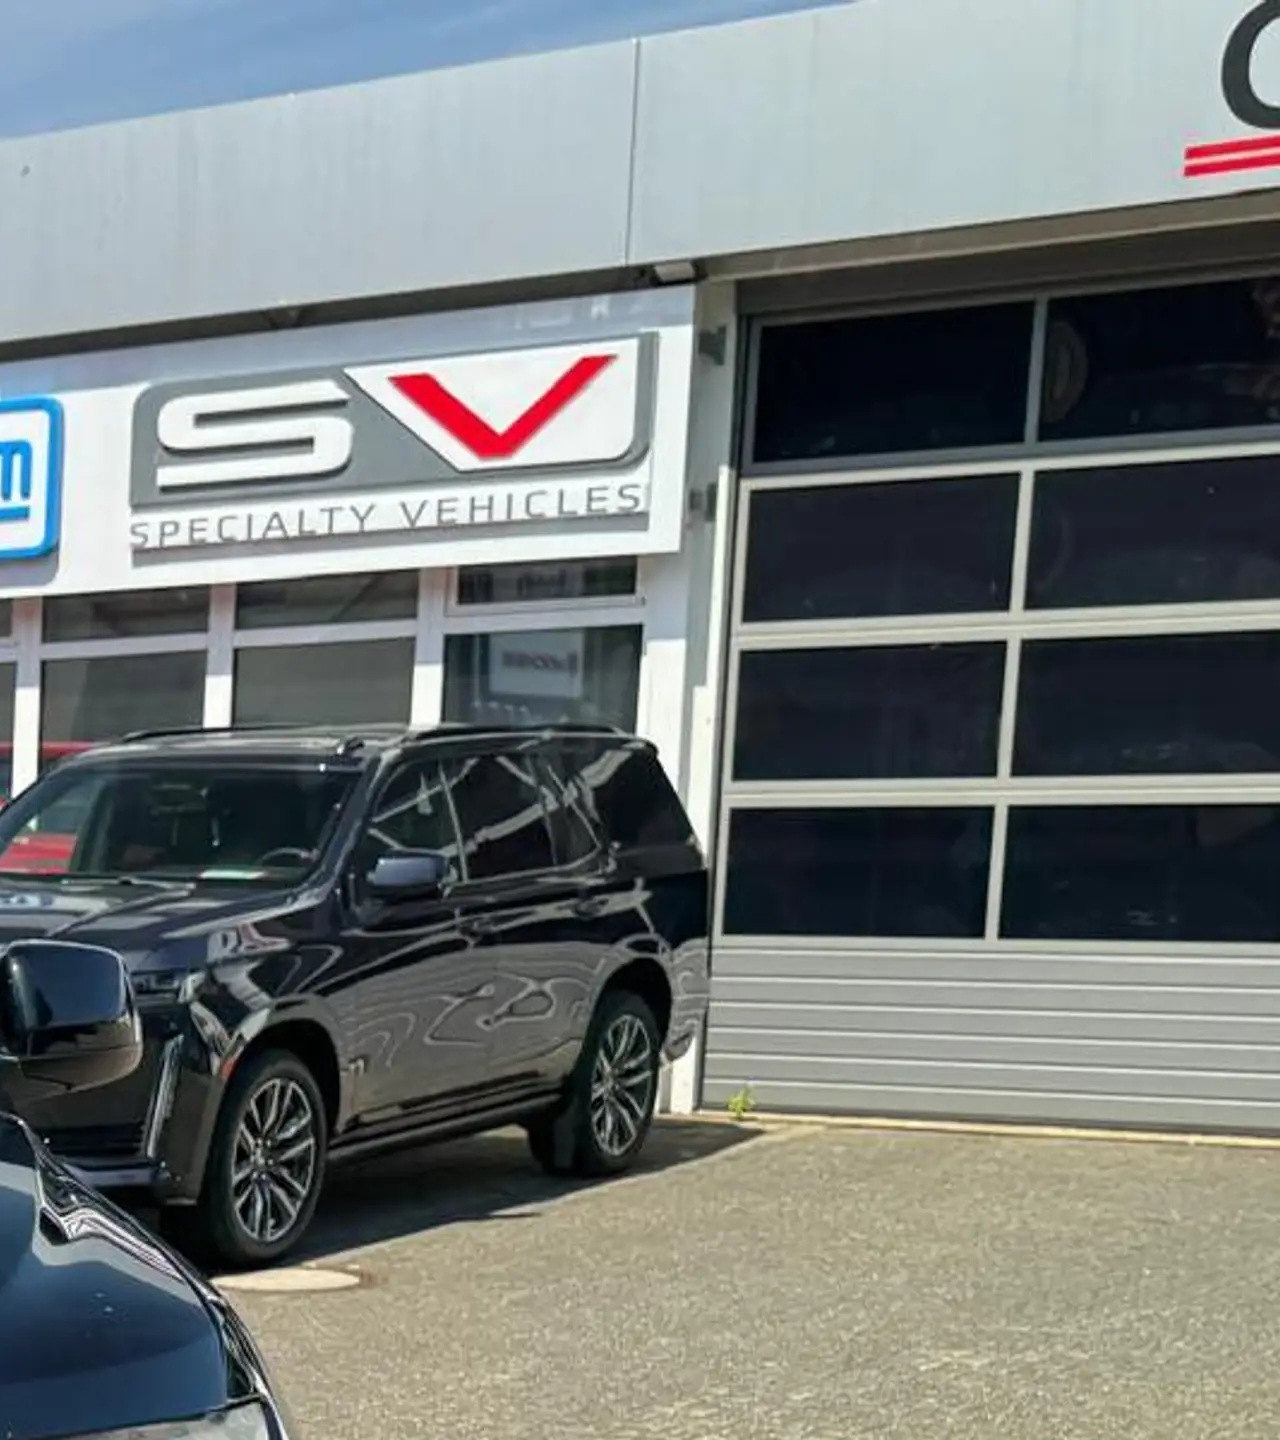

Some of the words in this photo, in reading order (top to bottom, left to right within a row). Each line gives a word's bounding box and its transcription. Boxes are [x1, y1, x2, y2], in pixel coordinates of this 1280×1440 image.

[157, 355, 618, 488] SV
[130, 503, 376, 549] SPECIALTY
[400, 484, 642, 529] VEHICLES
